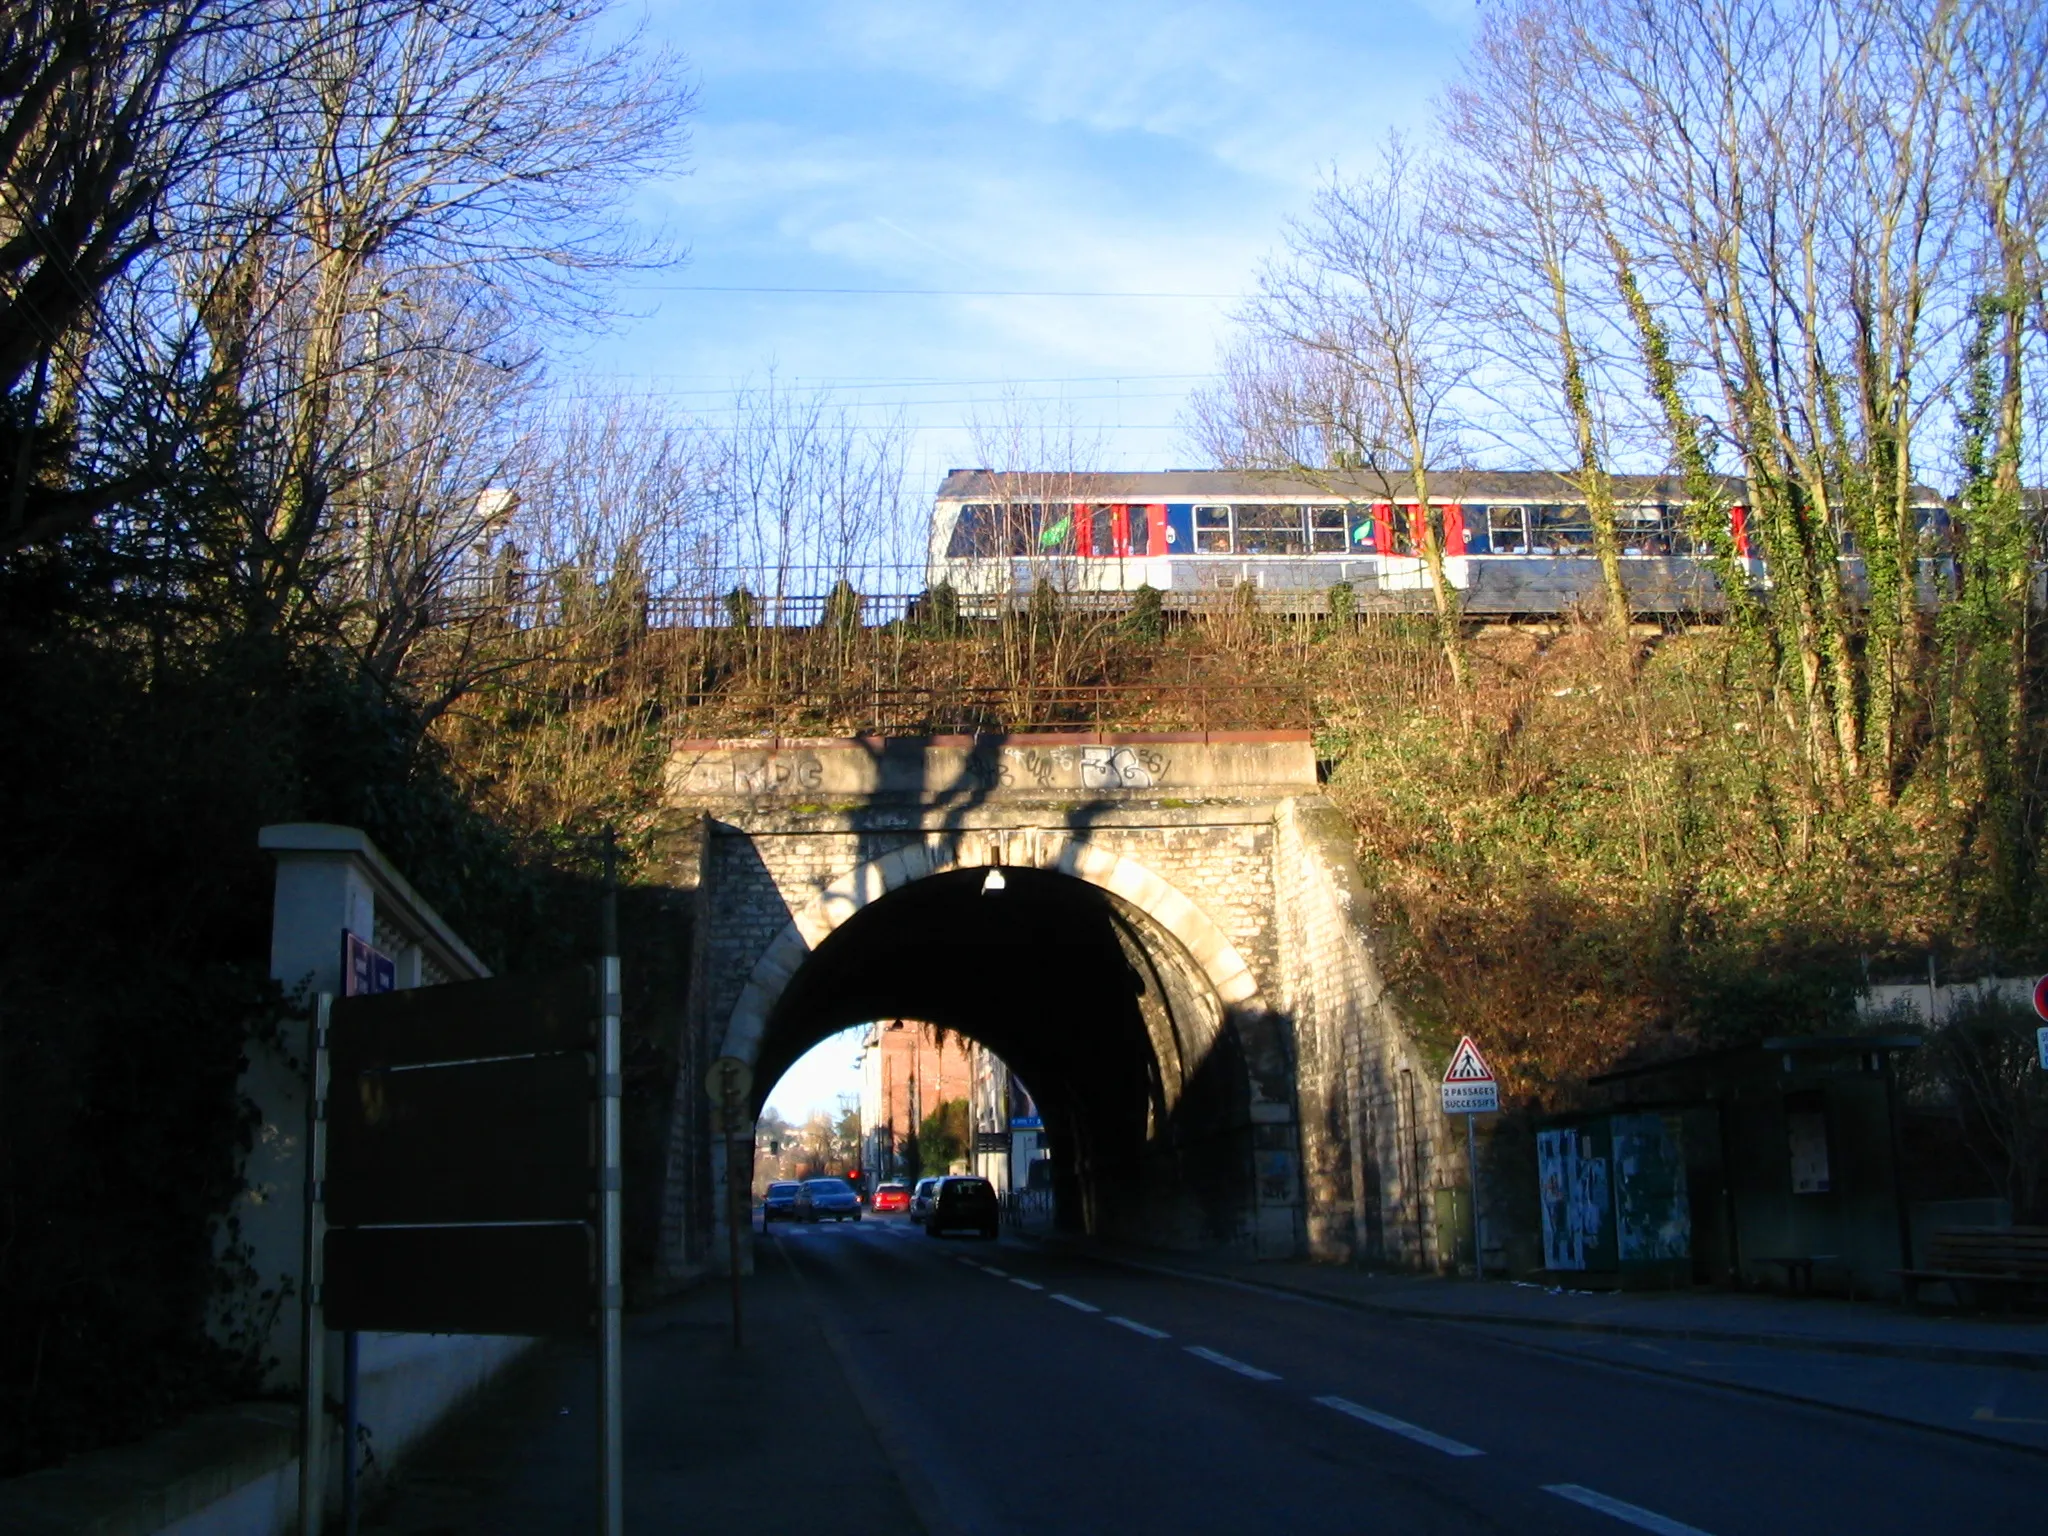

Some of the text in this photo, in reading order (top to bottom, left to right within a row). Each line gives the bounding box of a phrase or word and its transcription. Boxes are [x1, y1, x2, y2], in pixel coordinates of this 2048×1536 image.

[1444, 1087, 1495, 1096] 2 PASSAGES
[1444, 1099, 1496, 1108] SUCCESSIFS
